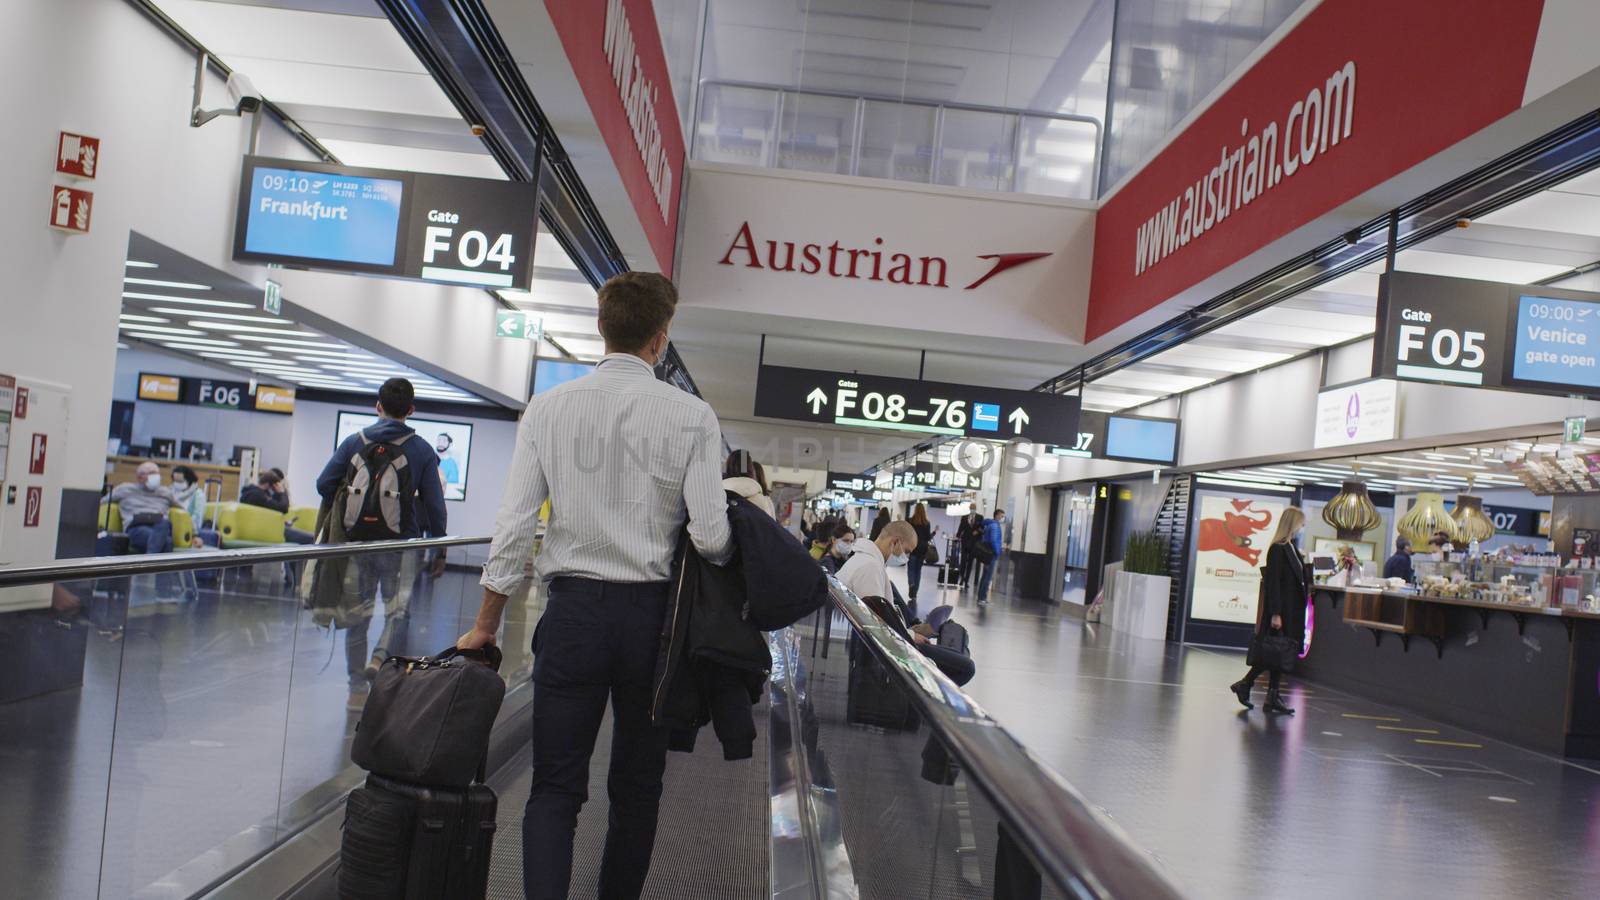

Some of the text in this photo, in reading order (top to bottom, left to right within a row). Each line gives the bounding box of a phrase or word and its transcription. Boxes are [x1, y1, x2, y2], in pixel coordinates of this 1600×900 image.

[1134, 60, 1357, 277] www.austrian.com
[262, 175, 309, 193] 09:10
[260, 197, 348, 221] Frankfurt
[427, 209, 460, 224] Gate
[423, 226, 516, 271] F 04
[718, 220, 949, 289] Austrian
[1401, 308, 1432, 323] Gate
[1529, 303, 1574, 321] 09:00
[1528, 325, 1587, 345] Venice
[1397, 324, 1486, 369] F 05
[1525, 350, 1596, 368] gate open
[838, 379, 859, 388] Gates
[199, 384, 213, 402] F
[214, 386, 240, 405] 06
[835, 388, 967, 429] F 08–76
[1494, 512, 1517, 530] 07
